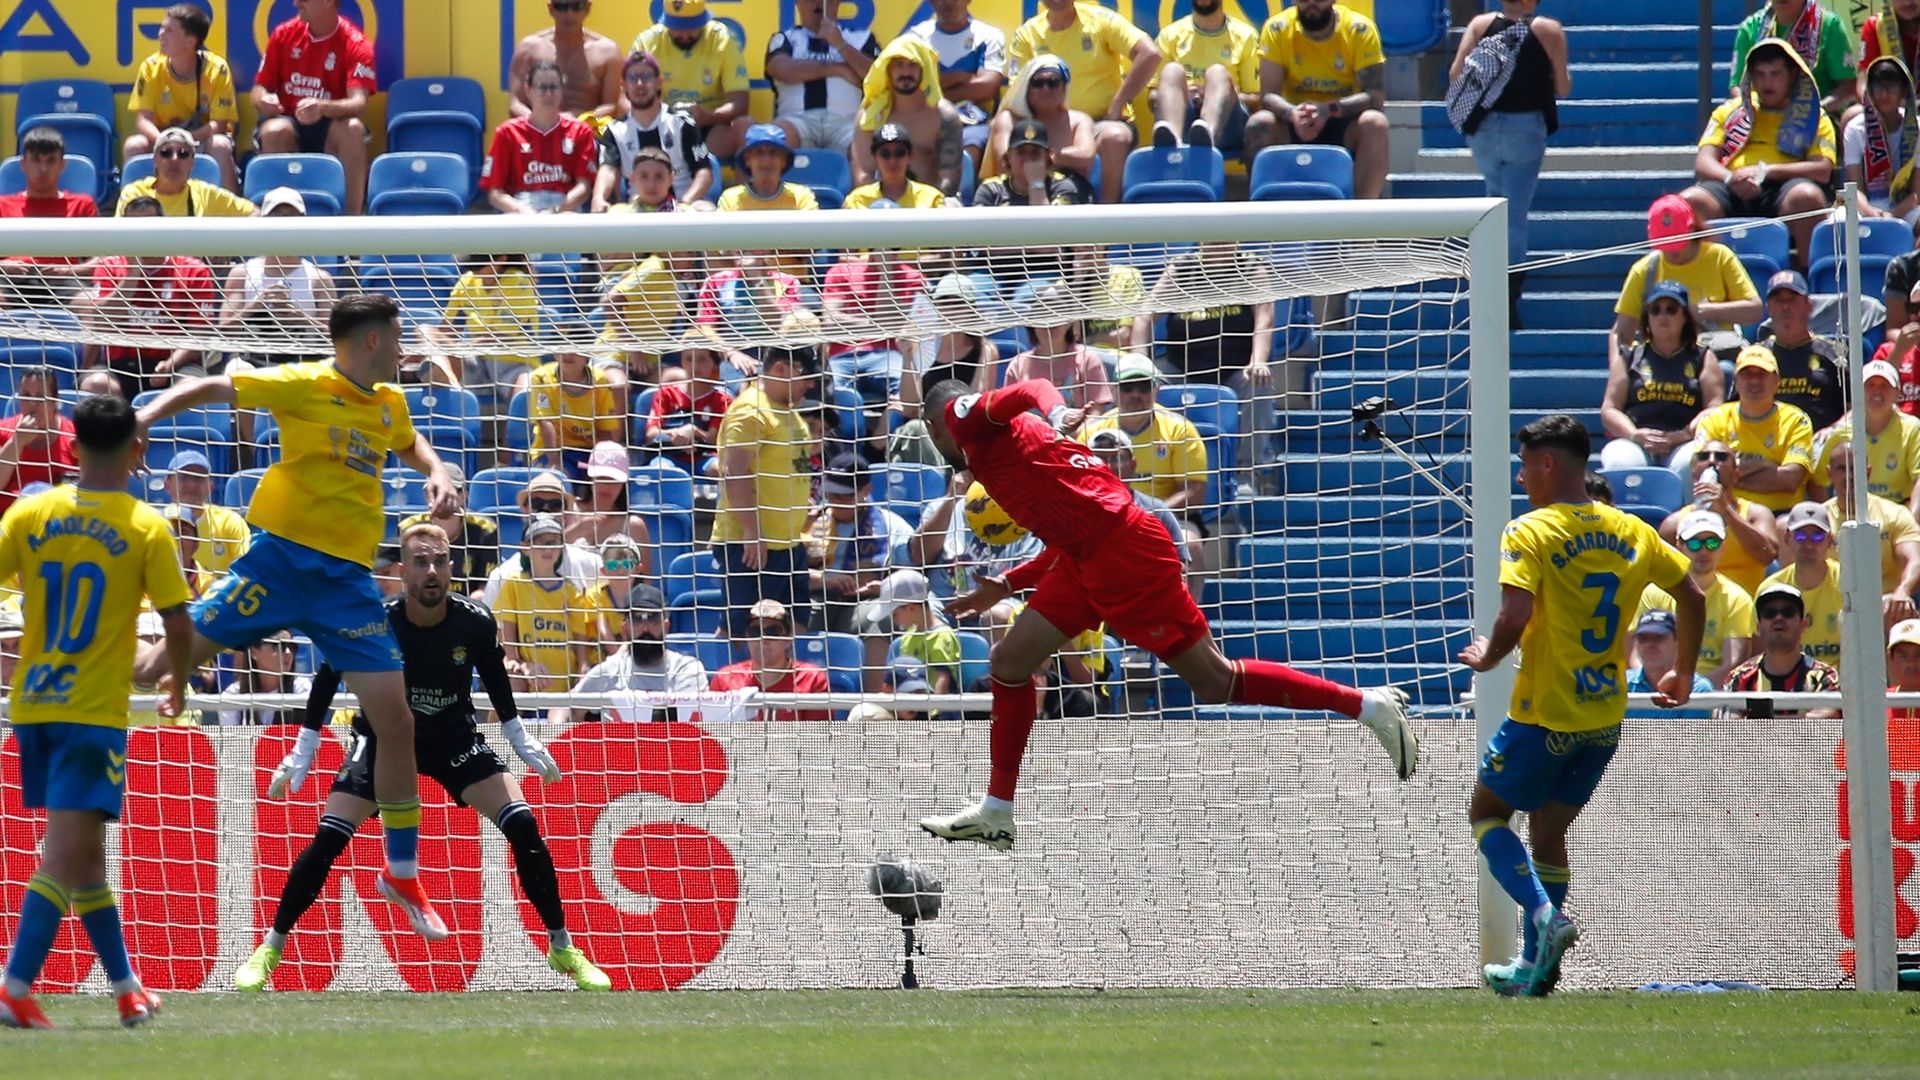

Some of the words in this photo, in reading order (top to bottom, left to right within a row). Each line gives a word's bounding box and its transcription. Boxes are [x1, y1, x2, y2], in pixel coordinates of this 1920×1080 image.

[1644, 380, 1685, 392] Gran
[1550, 531, 1638, 569] S.CARDONA
[38, 560, 107, 655] 10
[226, 575, 268, 617] 15
[338, 618, 389, 640] Cordial
[1580, 571, 1621, 655] 3
[411, 694, 458, 708] CANARIA
[450, 740, 491, 768] Cordia
